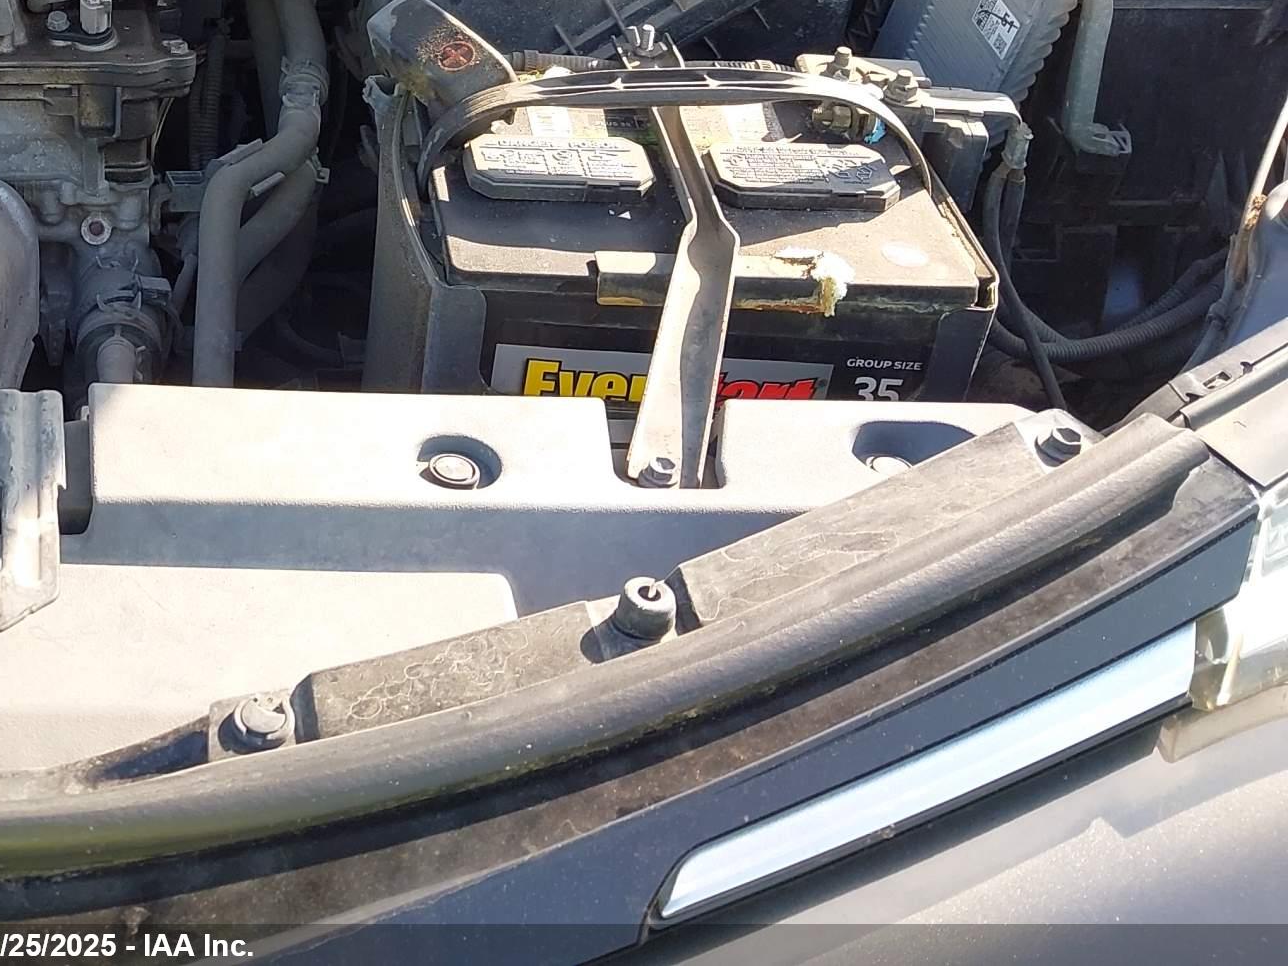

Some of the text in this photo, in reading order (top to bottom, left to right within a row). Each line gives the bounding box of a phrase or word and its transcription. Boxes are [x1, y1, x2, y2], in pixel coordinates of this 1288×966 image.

[846, 358, 923, 371] GROUP SIZE
[854, 376, 904, 402] 35
